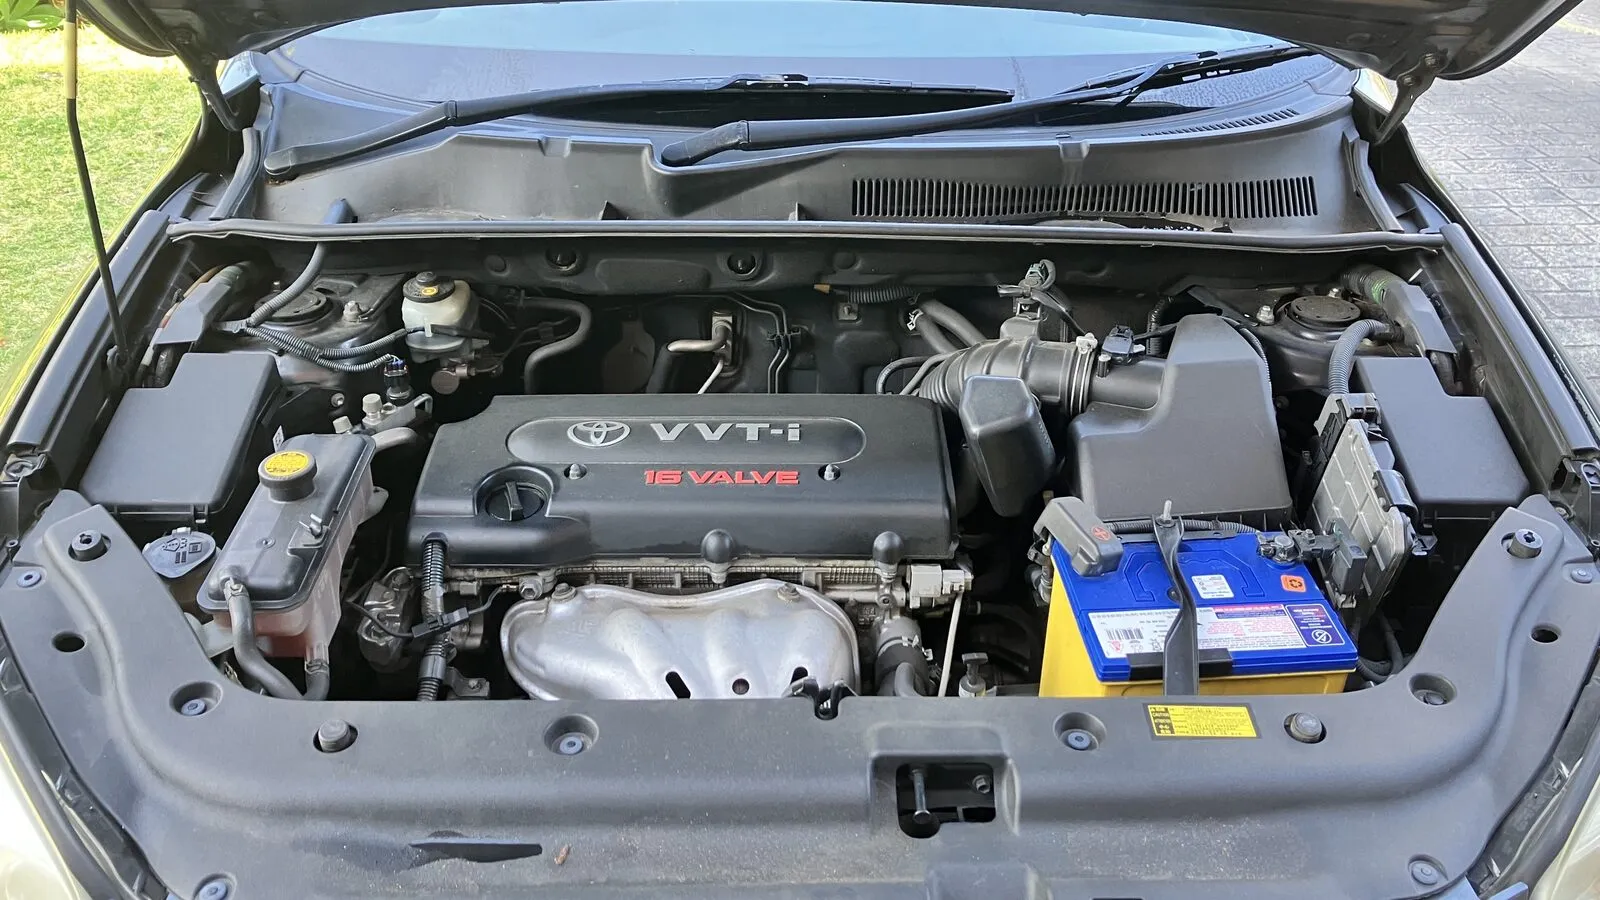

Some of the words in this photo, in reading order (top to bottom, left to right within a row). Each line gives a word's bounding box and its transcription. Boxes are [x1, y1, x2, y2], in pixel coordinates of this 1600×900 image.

[650, 423, 800, 441] VVT-i
[644, 470, 684, 485] 16
[687, 470, 800, 485] VALVE
